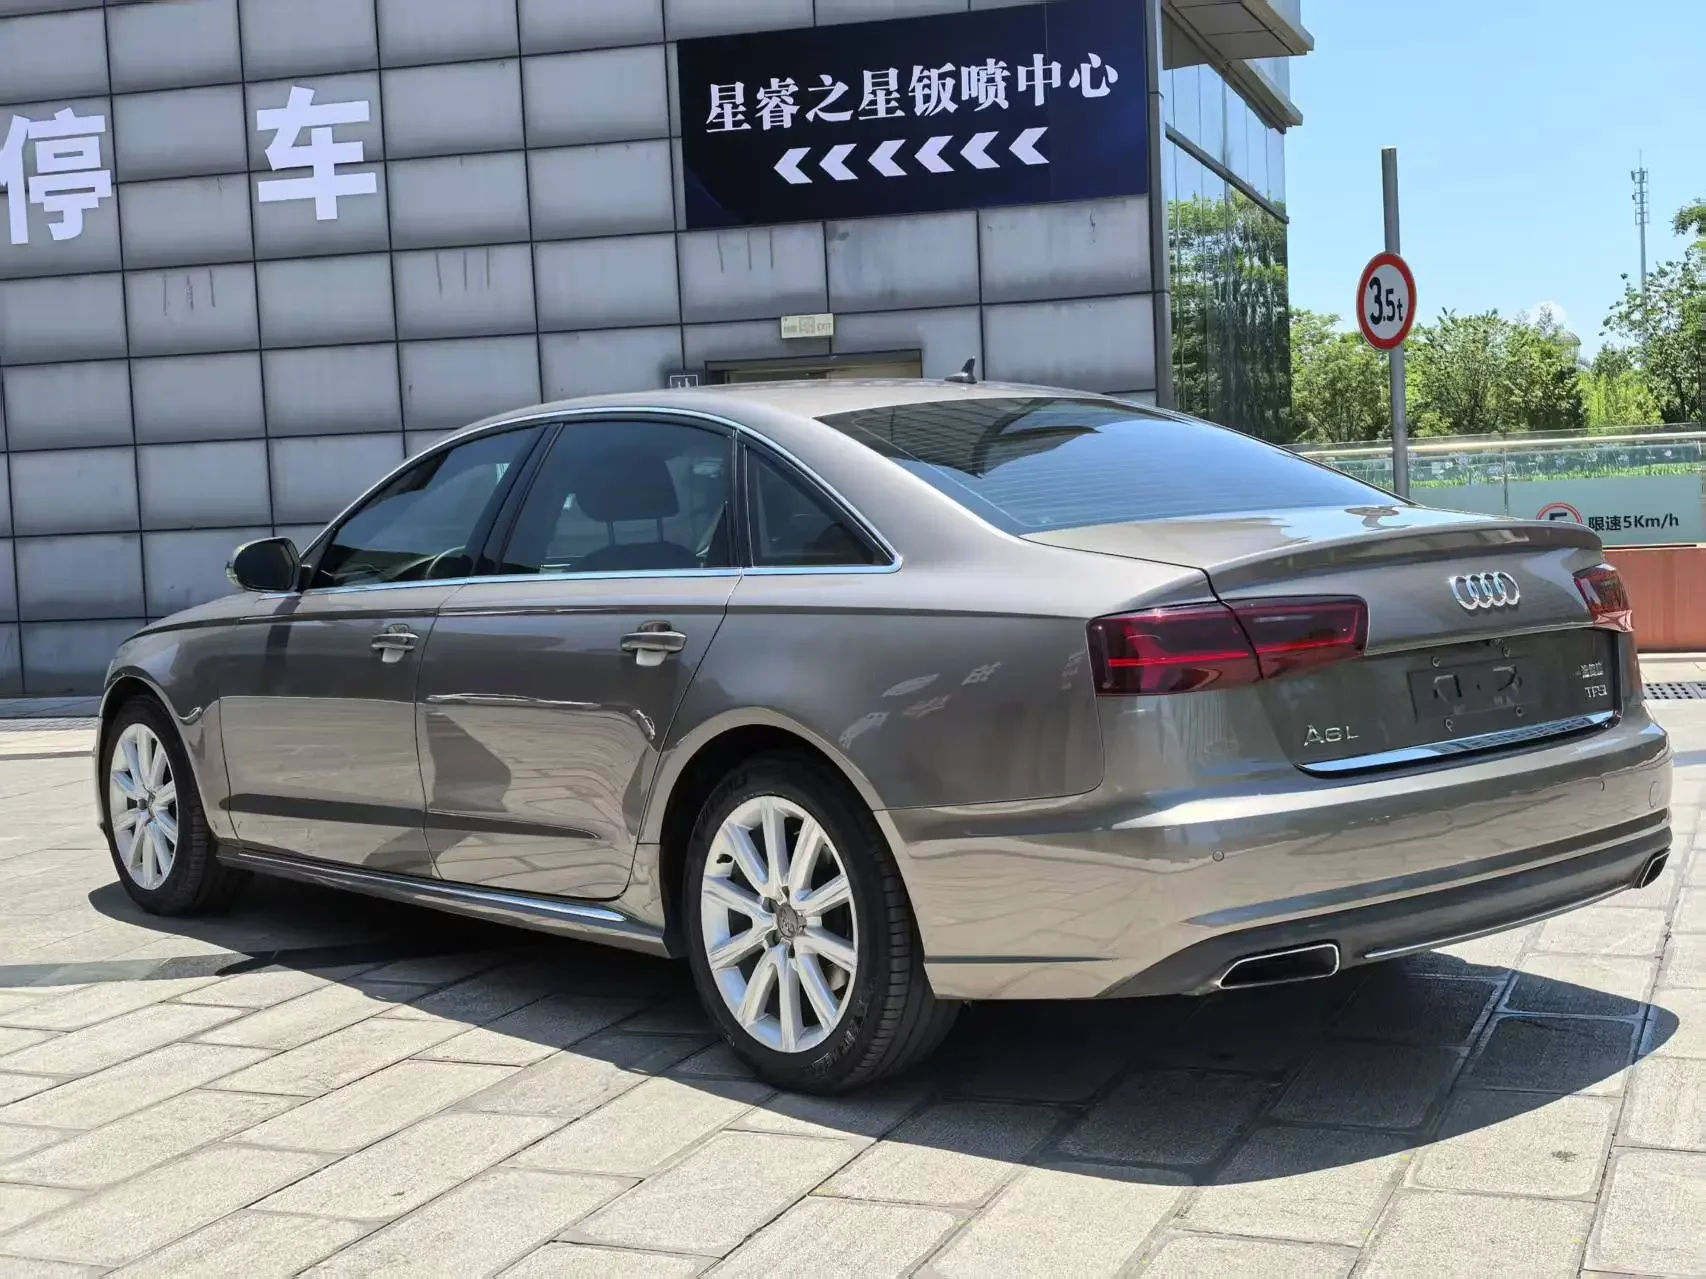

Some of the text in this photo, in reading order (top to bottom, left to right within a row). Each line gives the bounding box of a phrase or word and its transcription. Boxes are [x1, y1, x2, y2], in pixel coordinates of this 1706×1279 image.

[705, 52, 1119, 133] 星睿之星钣喷中心
[1369, 276, 1403, 325] 3.5t
[1588, 513, 1679, 531] 限速5Km/h
